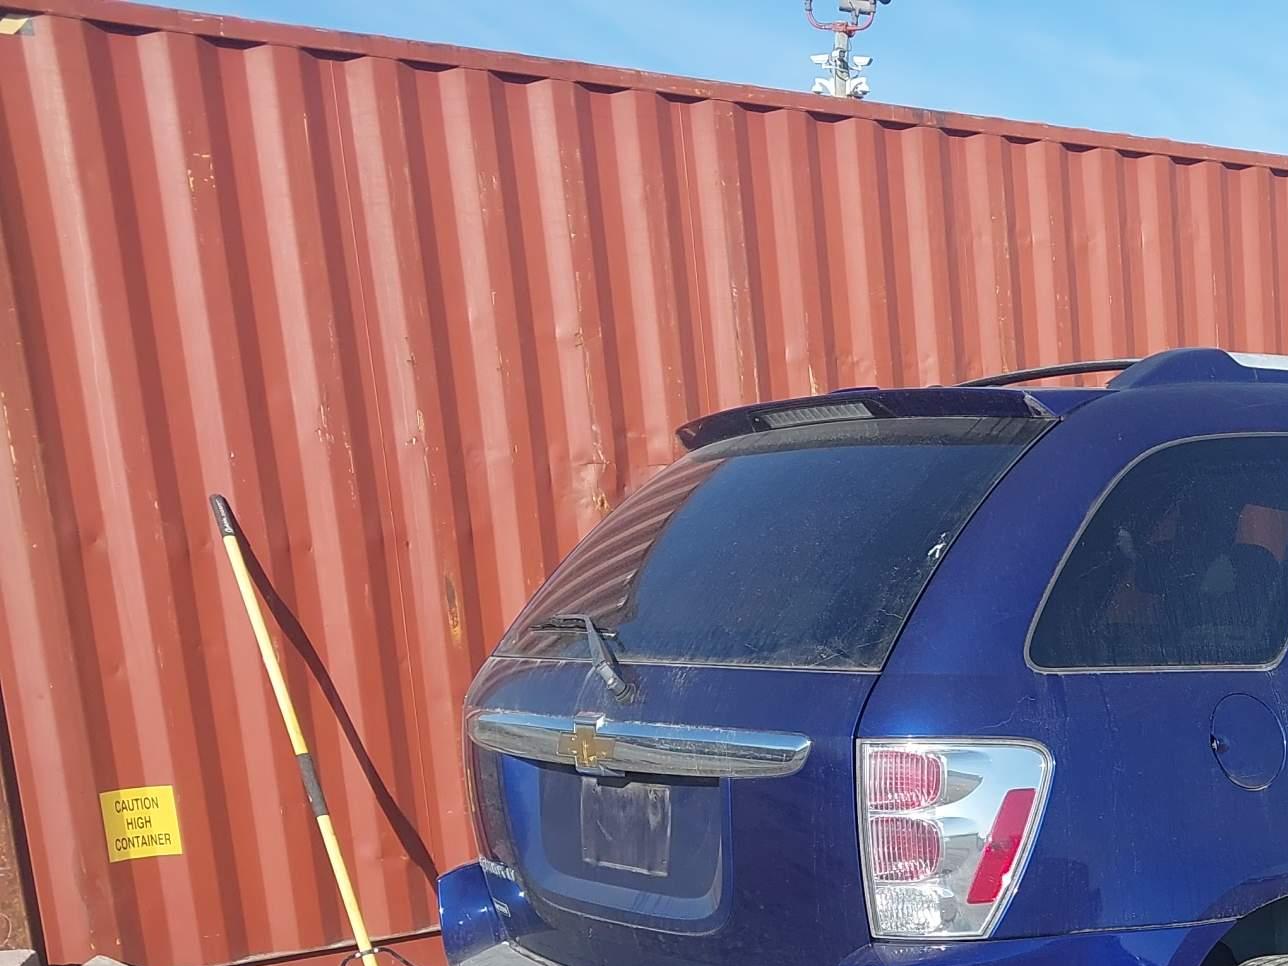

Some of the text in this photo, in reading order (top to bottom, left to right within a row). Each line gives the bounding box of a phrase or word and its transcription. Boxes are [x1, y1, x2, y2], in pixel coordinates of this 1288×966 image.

[114, 796, 159, 814] CAUTION
[126, 816, 152, 831] HIGH
[114, 833, 172, 852] CONTAINER
